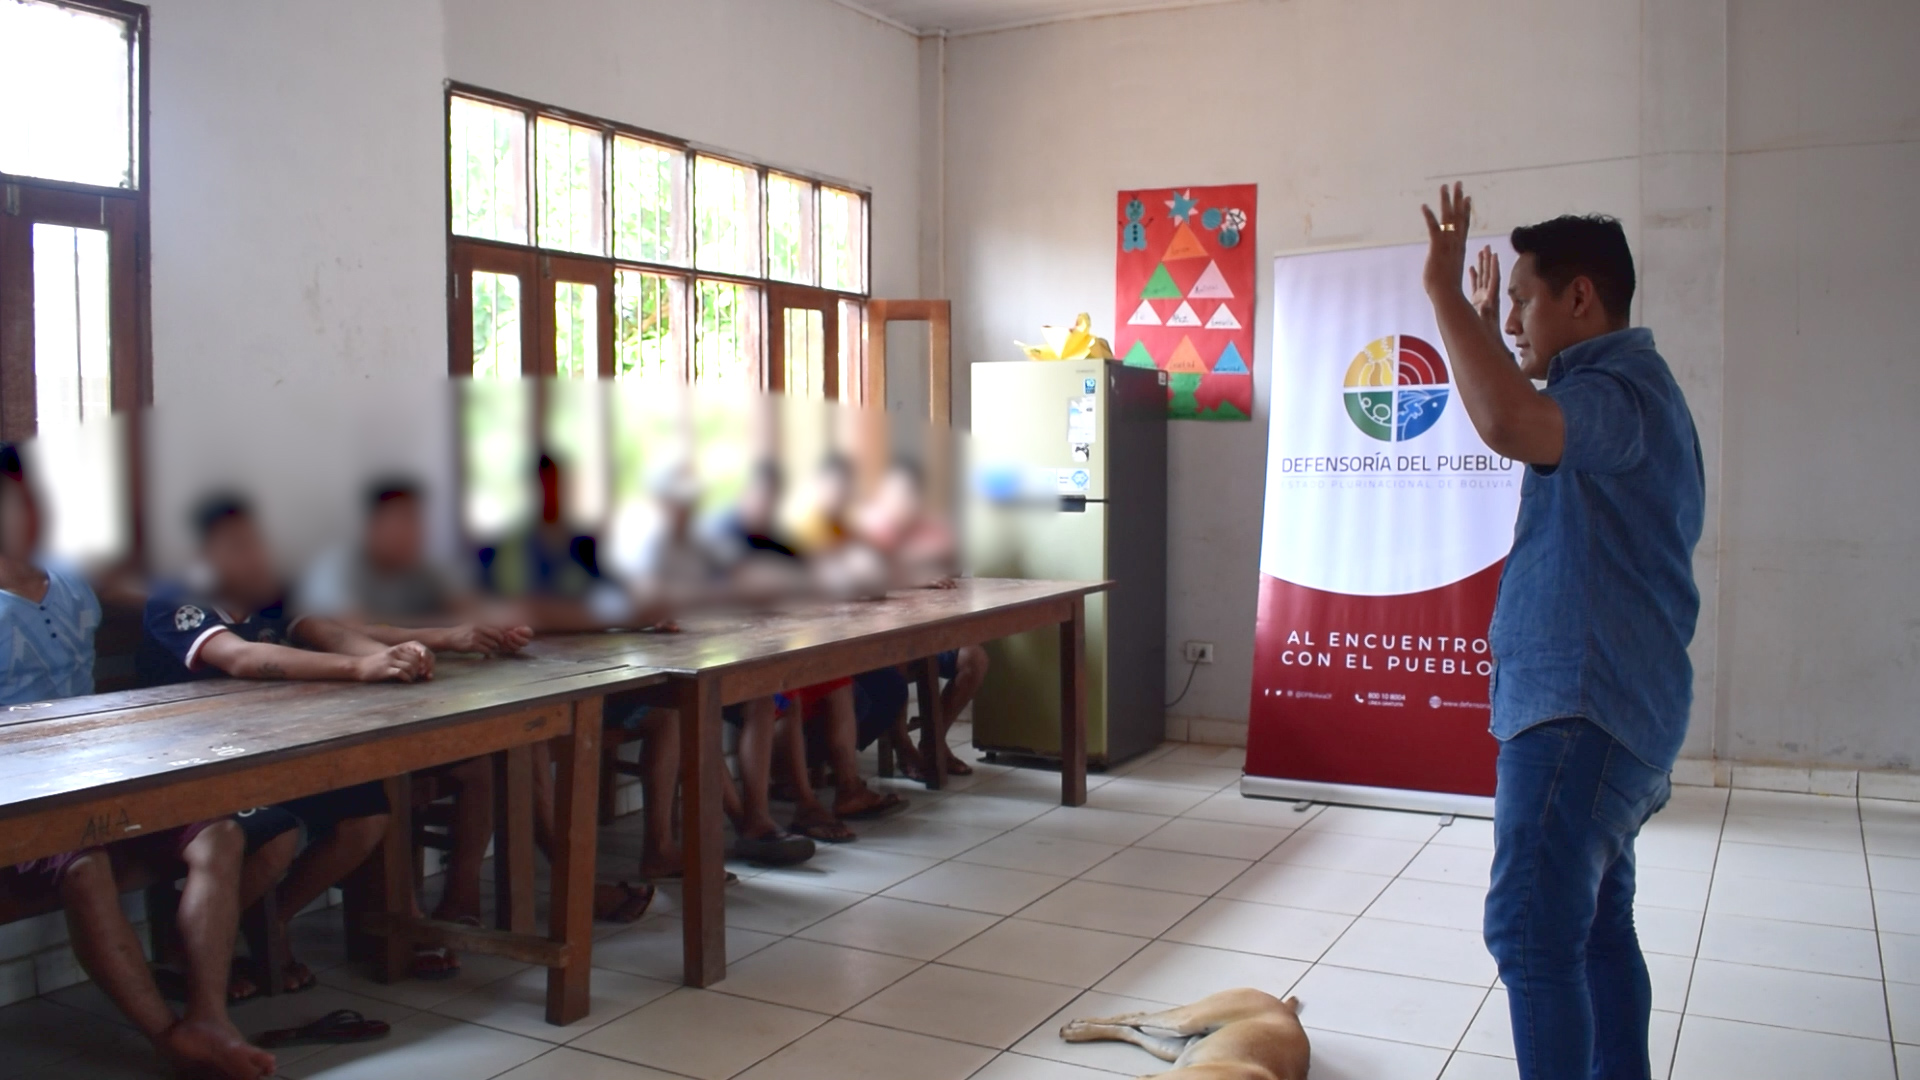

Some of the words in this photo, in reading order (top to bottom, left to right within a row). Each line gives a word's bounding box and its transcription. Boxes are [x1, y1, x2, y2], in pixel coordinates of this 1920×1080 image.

[1282, 452, 1391, 473] DEFENSORÍA
[1397, 456, 1431, 471] DEL
[1437, 454, 1512, 471] PUEBLO
[1331, 479, 1432, 489] PLURINACIONAL
[1438, 479, 1453, 489] DE
[1460, 479, 1513, 489] BOLIVIA
[1287, 630, 1315, 646] AL
[1329, 631, 1488, 654] ENCUENTRO
[1281, 650, 1331, 667] CON
[1346, 653, 1373, 670] EL
[1387, 655, 1492, 676] PUEBLO
